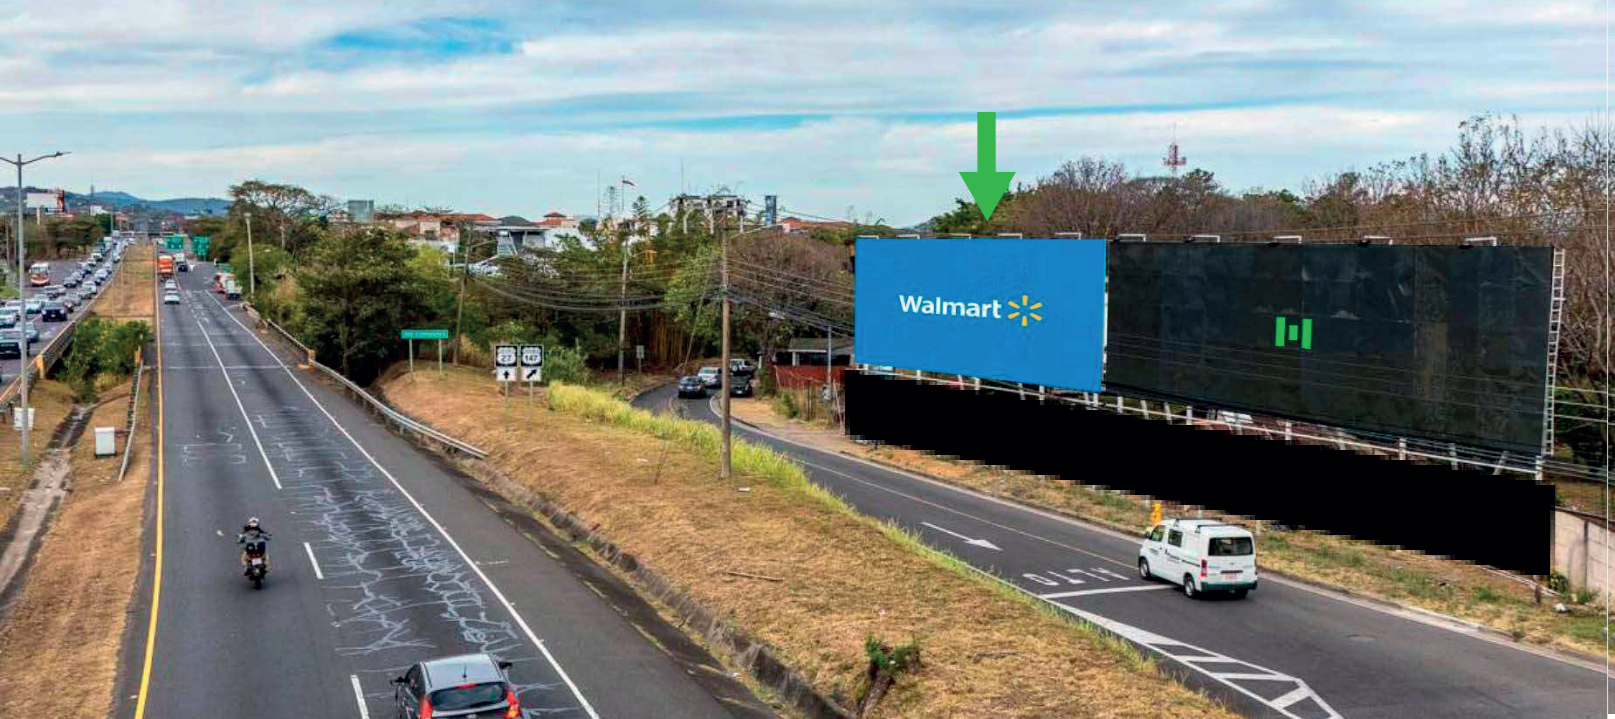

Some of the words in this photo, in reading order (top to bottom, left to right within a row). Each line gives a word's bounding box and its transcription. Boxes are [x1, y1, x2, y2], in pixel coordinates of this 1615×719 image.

[899, 294, 1002, 319] Walmart
[501, 354, 512, 363] 27
[525, 354, 539, 362] 147
